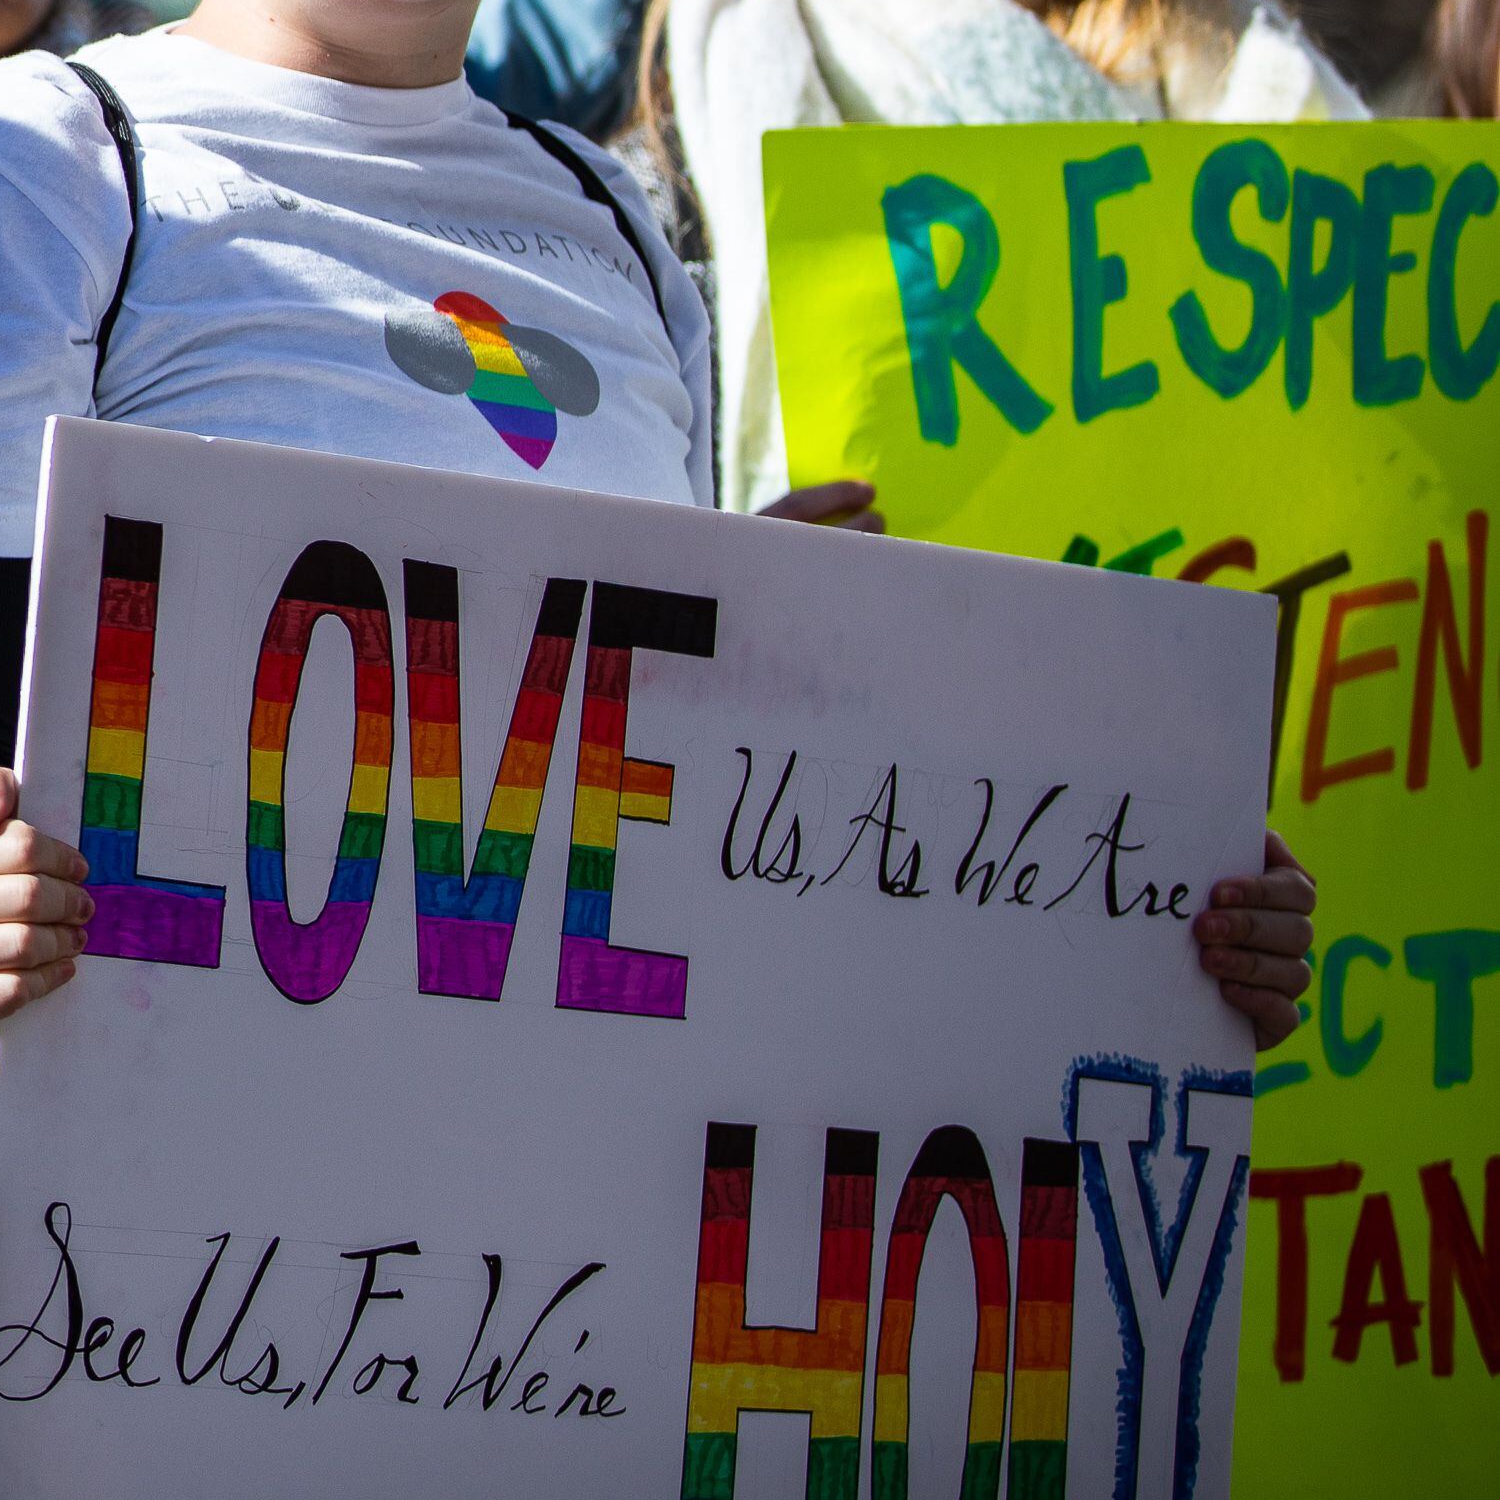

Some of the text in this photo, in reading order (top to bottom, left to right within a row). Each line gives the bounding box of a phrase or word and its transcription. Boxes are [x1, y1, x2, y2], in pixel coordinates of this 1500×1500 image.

[139, 180, 247, 223] THE
[384, 217, 634, 285] OUNDATION
[1062, 509, 1489, 813] TEN
[78, 513, 1191, 1019] LOVE Us, As We Are
[175, 1231, 308, 1409] Us,
[312, 1240, 421, 1406] For
[442, 1252, 627, 1419] We're
